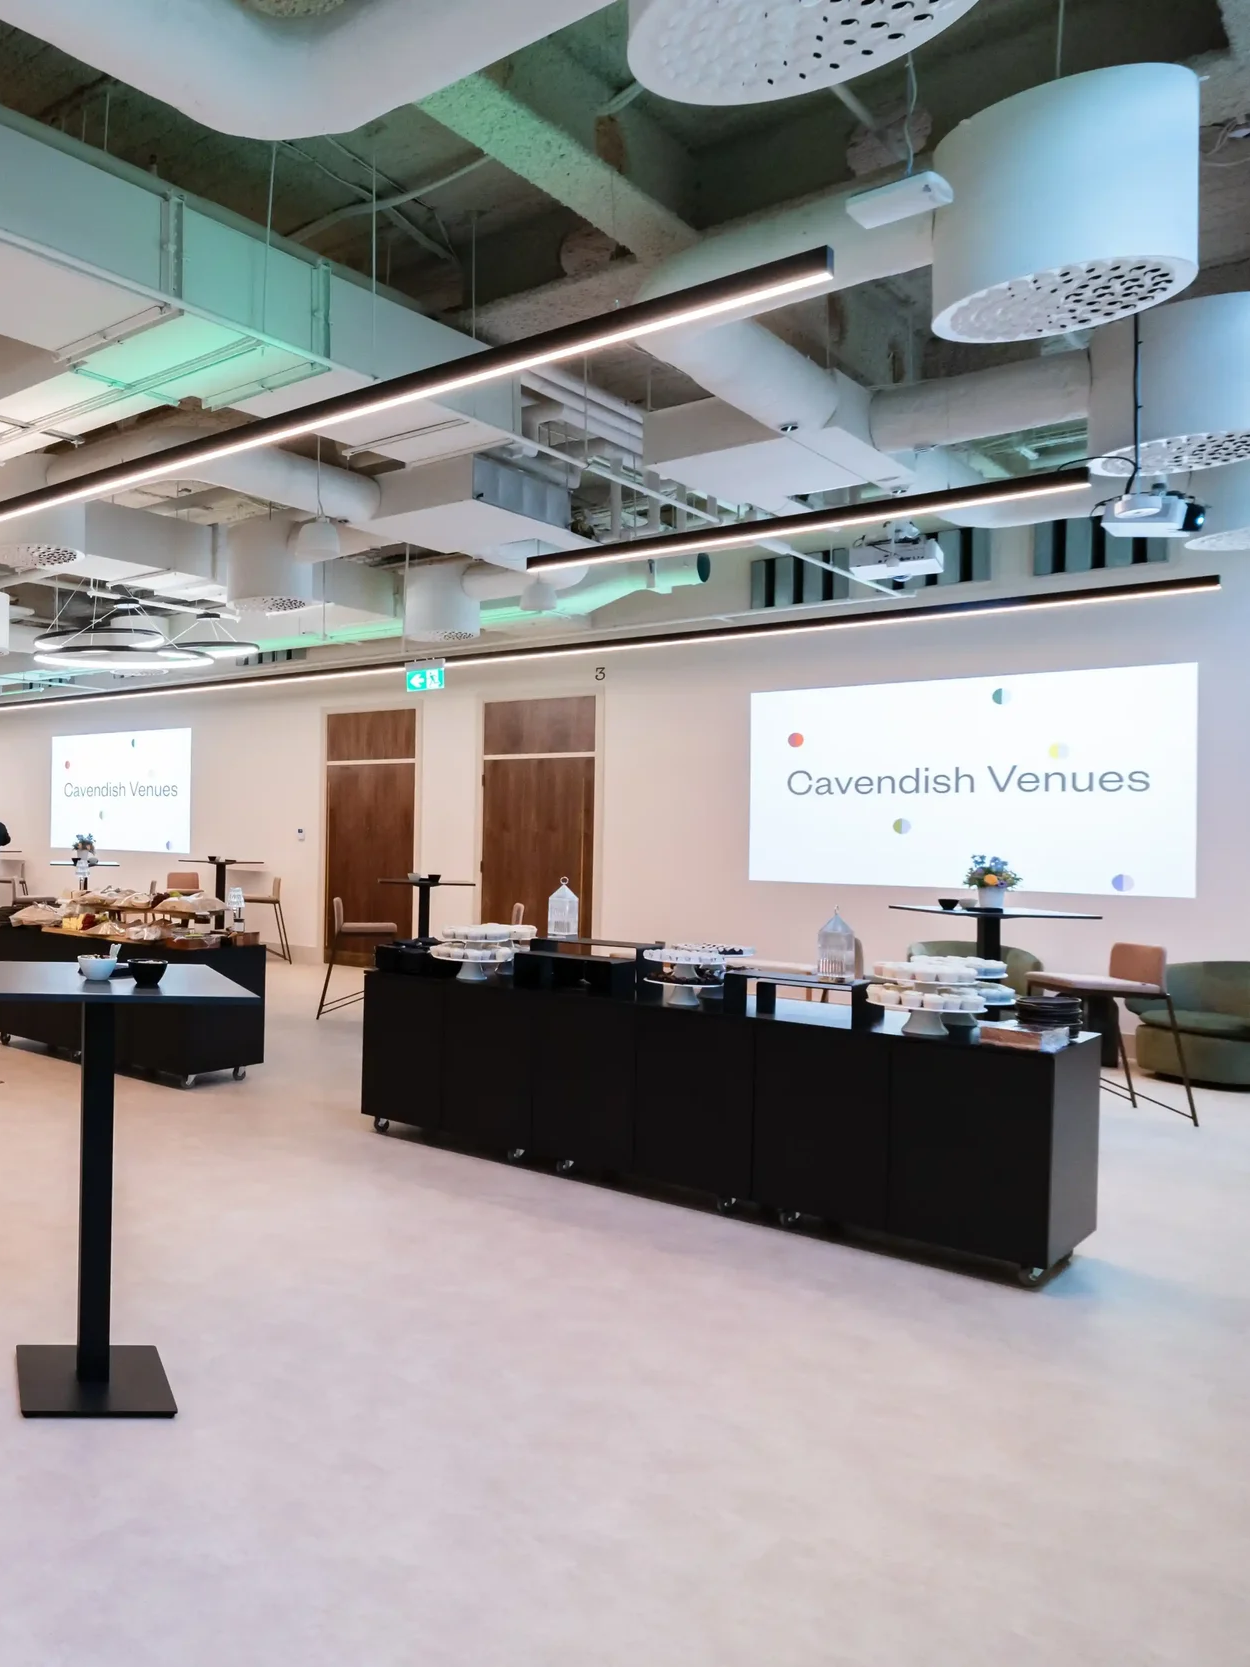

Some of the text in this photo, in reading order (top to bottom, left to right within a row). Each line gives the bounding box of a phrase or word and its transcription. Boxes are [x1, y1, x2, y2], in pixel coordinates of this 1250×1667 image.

[594, 666, 607, 681] 3
[63, 780, 179, 798] Cavendish Venues
[785, 764, 1151, 796] Cavendish Venues
